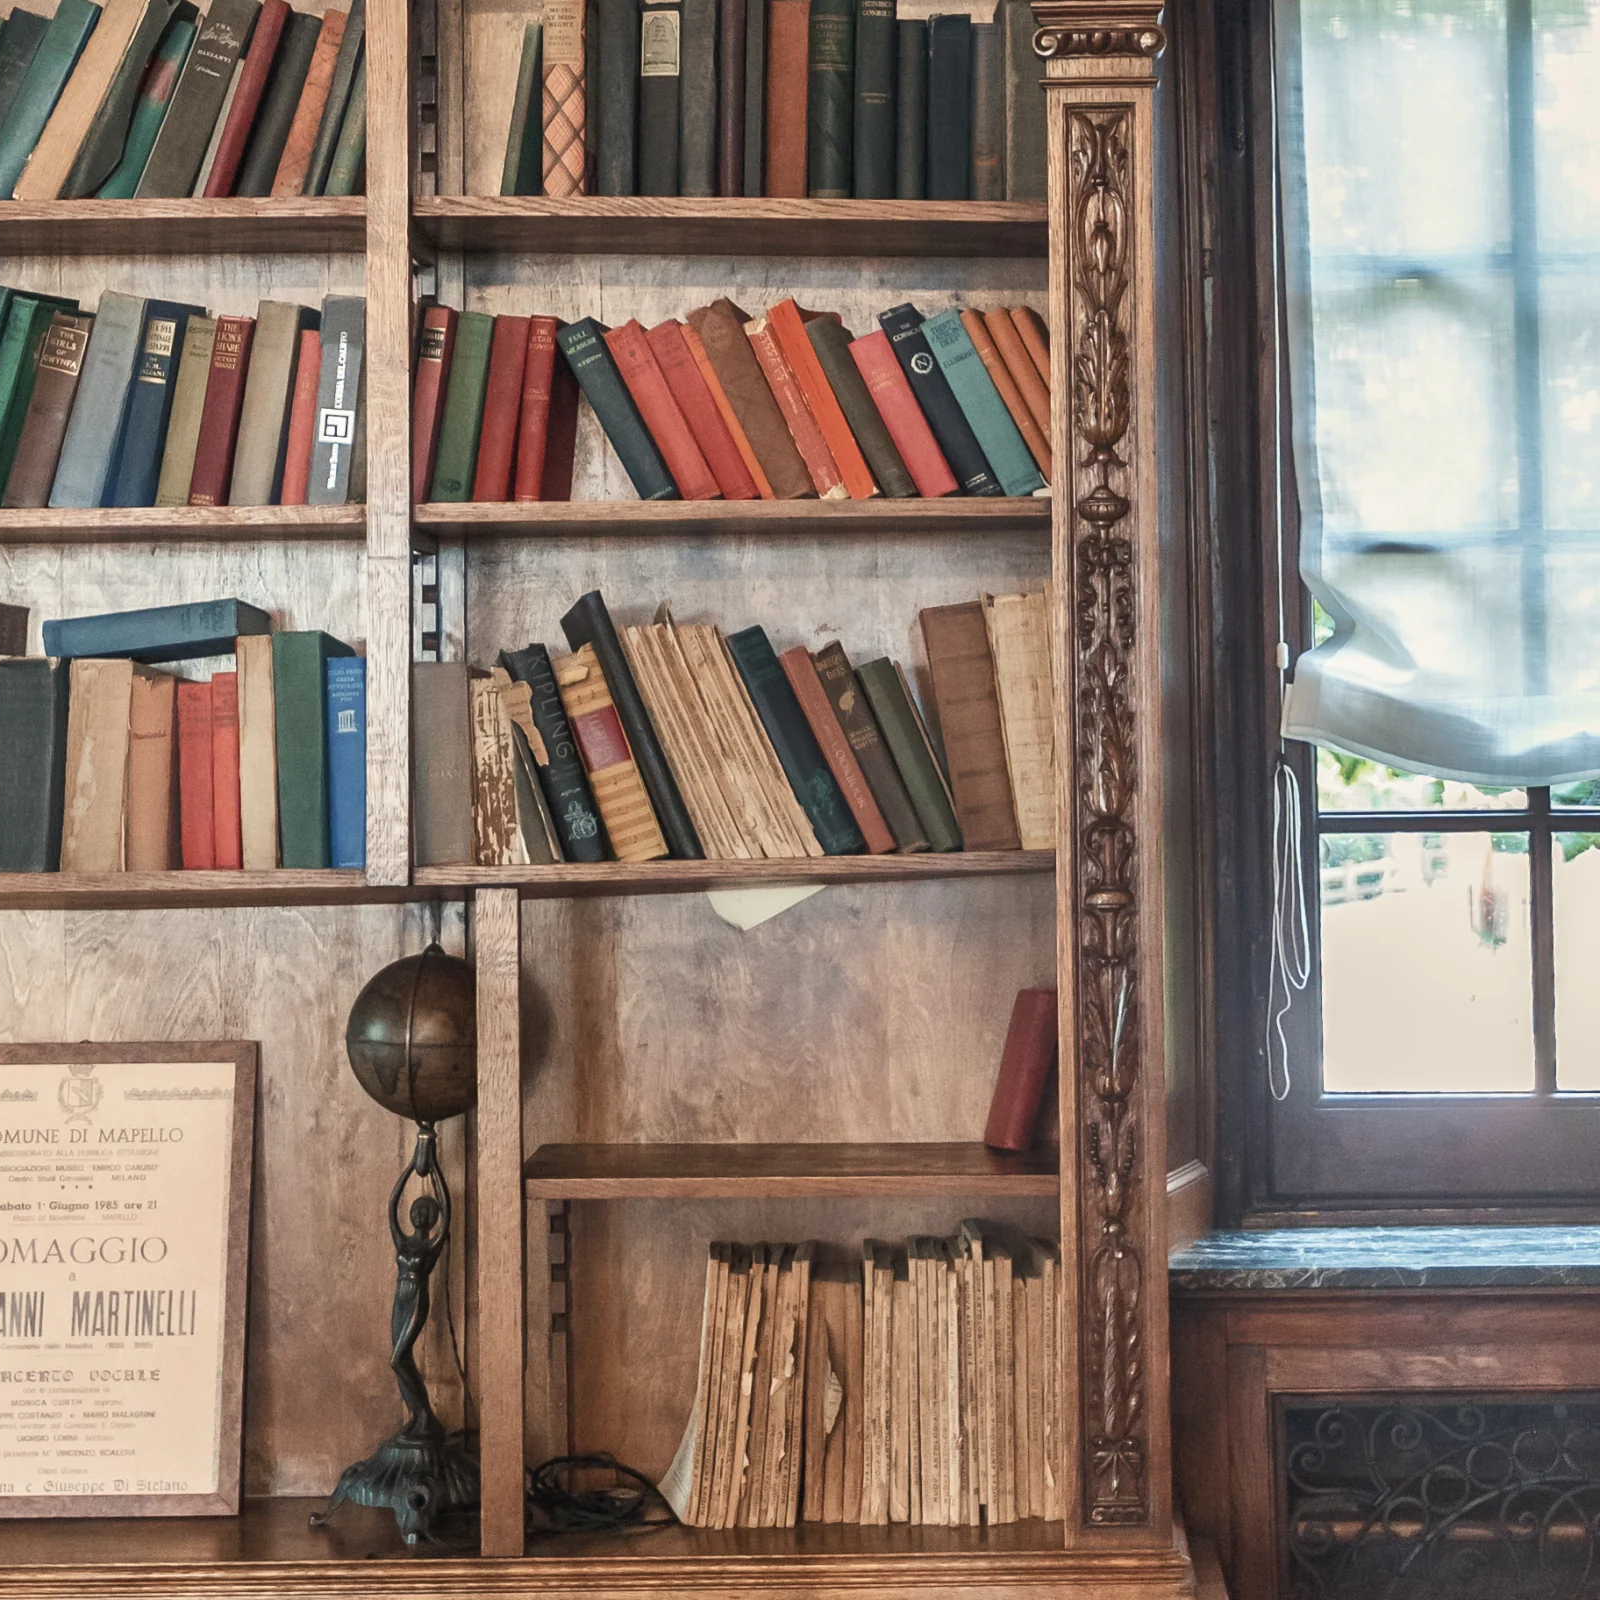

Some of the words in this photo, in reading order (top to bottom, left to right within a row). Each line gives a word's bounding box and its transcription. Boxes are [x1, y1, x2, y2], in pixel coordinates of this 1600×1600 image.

[222, 322, 239, 332] THE
[59, 330, 75, 341] THE
[527, 654, 574, 759] KIPLING
[70, 1129, 88, 1143] DI
[98, 1127, 184, 1143] MAPELLO
[49, 1201, 90, 1212] Giugno
[94, 1200, 118, 1210] 1985
[147, 1200, 157, 1210] 21
[68, 1271, 77, 1282] a
[70, 1290, 197, 1337] MARTINELLI
[17, 1411, 62, 1419] COSTANZO
[43, 1480, 106, 1494] Giuseppe
[113, 1479, 130, 1492] Di
[136, 1479, 188, 1492] Stefano
